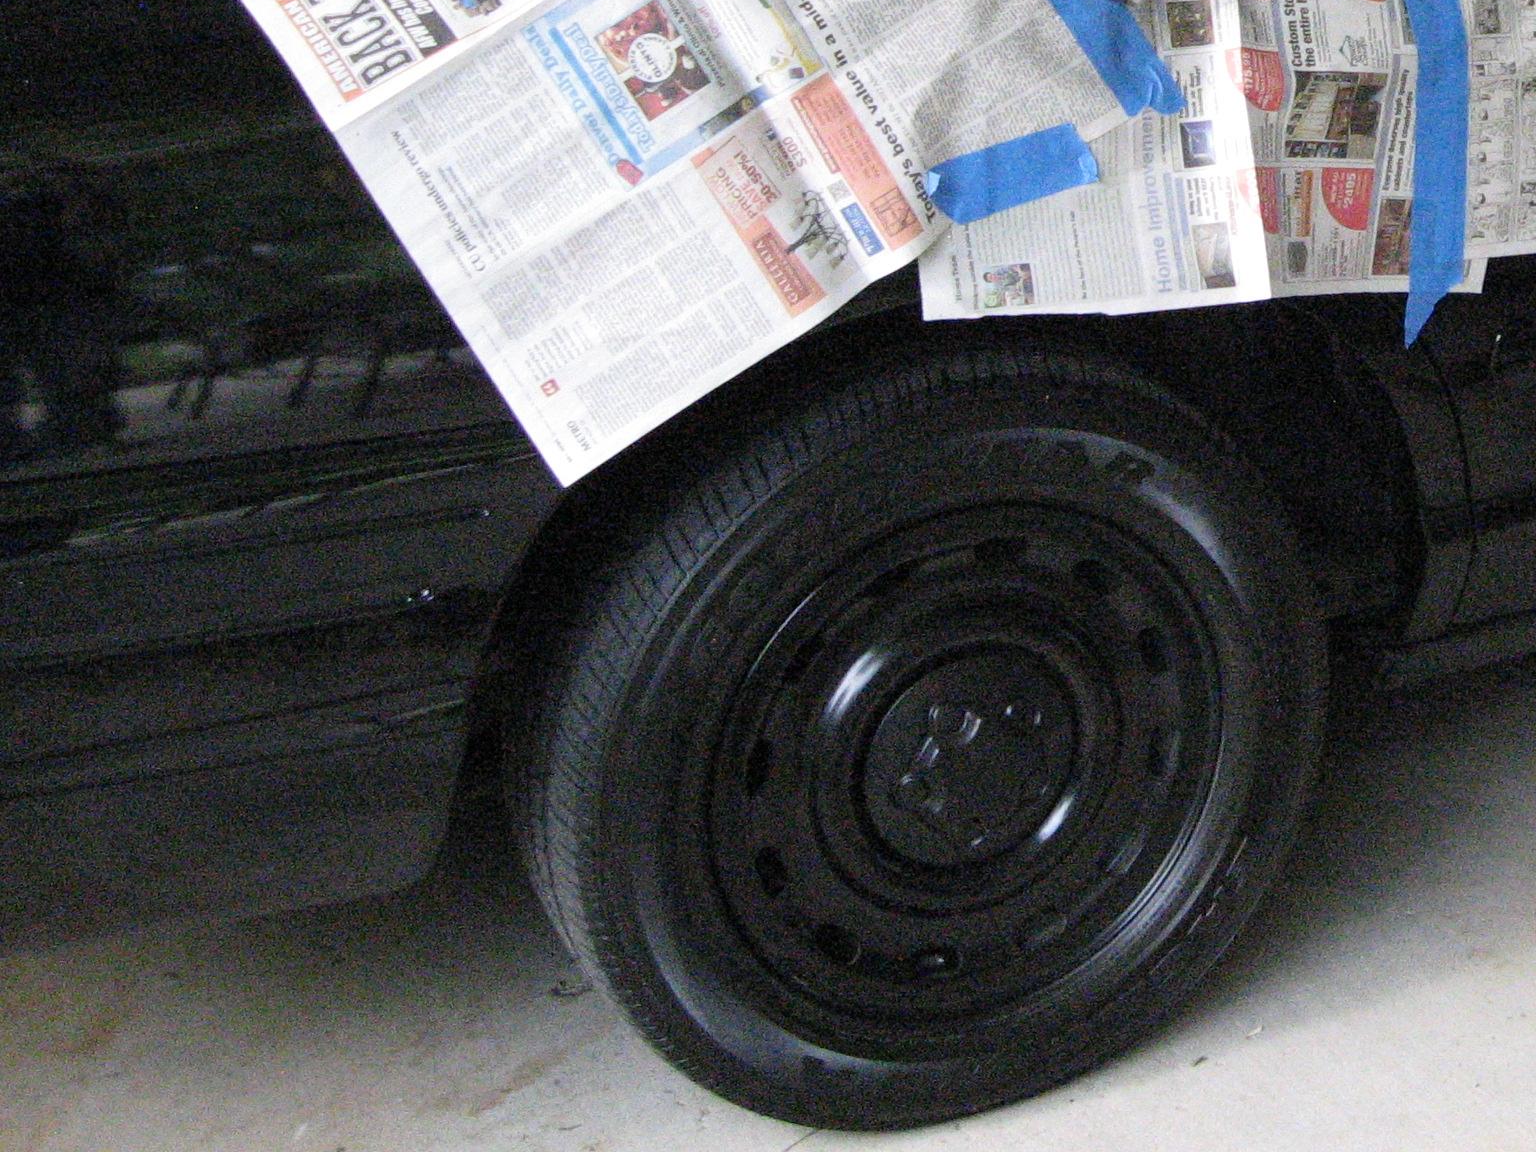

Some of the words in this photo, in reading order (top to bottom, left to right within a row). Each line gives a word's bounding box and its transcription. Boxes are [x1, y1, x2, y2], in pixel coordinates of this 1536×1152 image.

[522, 23, 560, 72] Deals
[563, 21, 597, 61] Deal
[822, 32, 837, 47] a
[1287, 20, 1302, 66] Custom
[1300, 7, 1312, 44] entire
[585, 52, 626, 103] Daily
[829, 48, 849, 68] in
[1304, 46, 1315, 67] the
[551, 65, 590, 114] Daily
[842, 67, 880, 117] value
[388, 127, 421, 170] review
[578, 109, 623, 167] Denver
[781, 134, 808, 168] $300
[872, 116, 906, 157] best
[412, 164, 450, 214] undergo
[897, 156, 939, 224] Today's
[1138, 107, 1162, 230] Improvemen
[714, 165, 759, 220] PRICING
[441, 209, 477, 255] policies
[467, 251, 487, 273] CU
[752, 238, 800, 303] GALLERIA
[1157, 239, 1175, 294] Home
[565, 417, 592, 452] METRO
